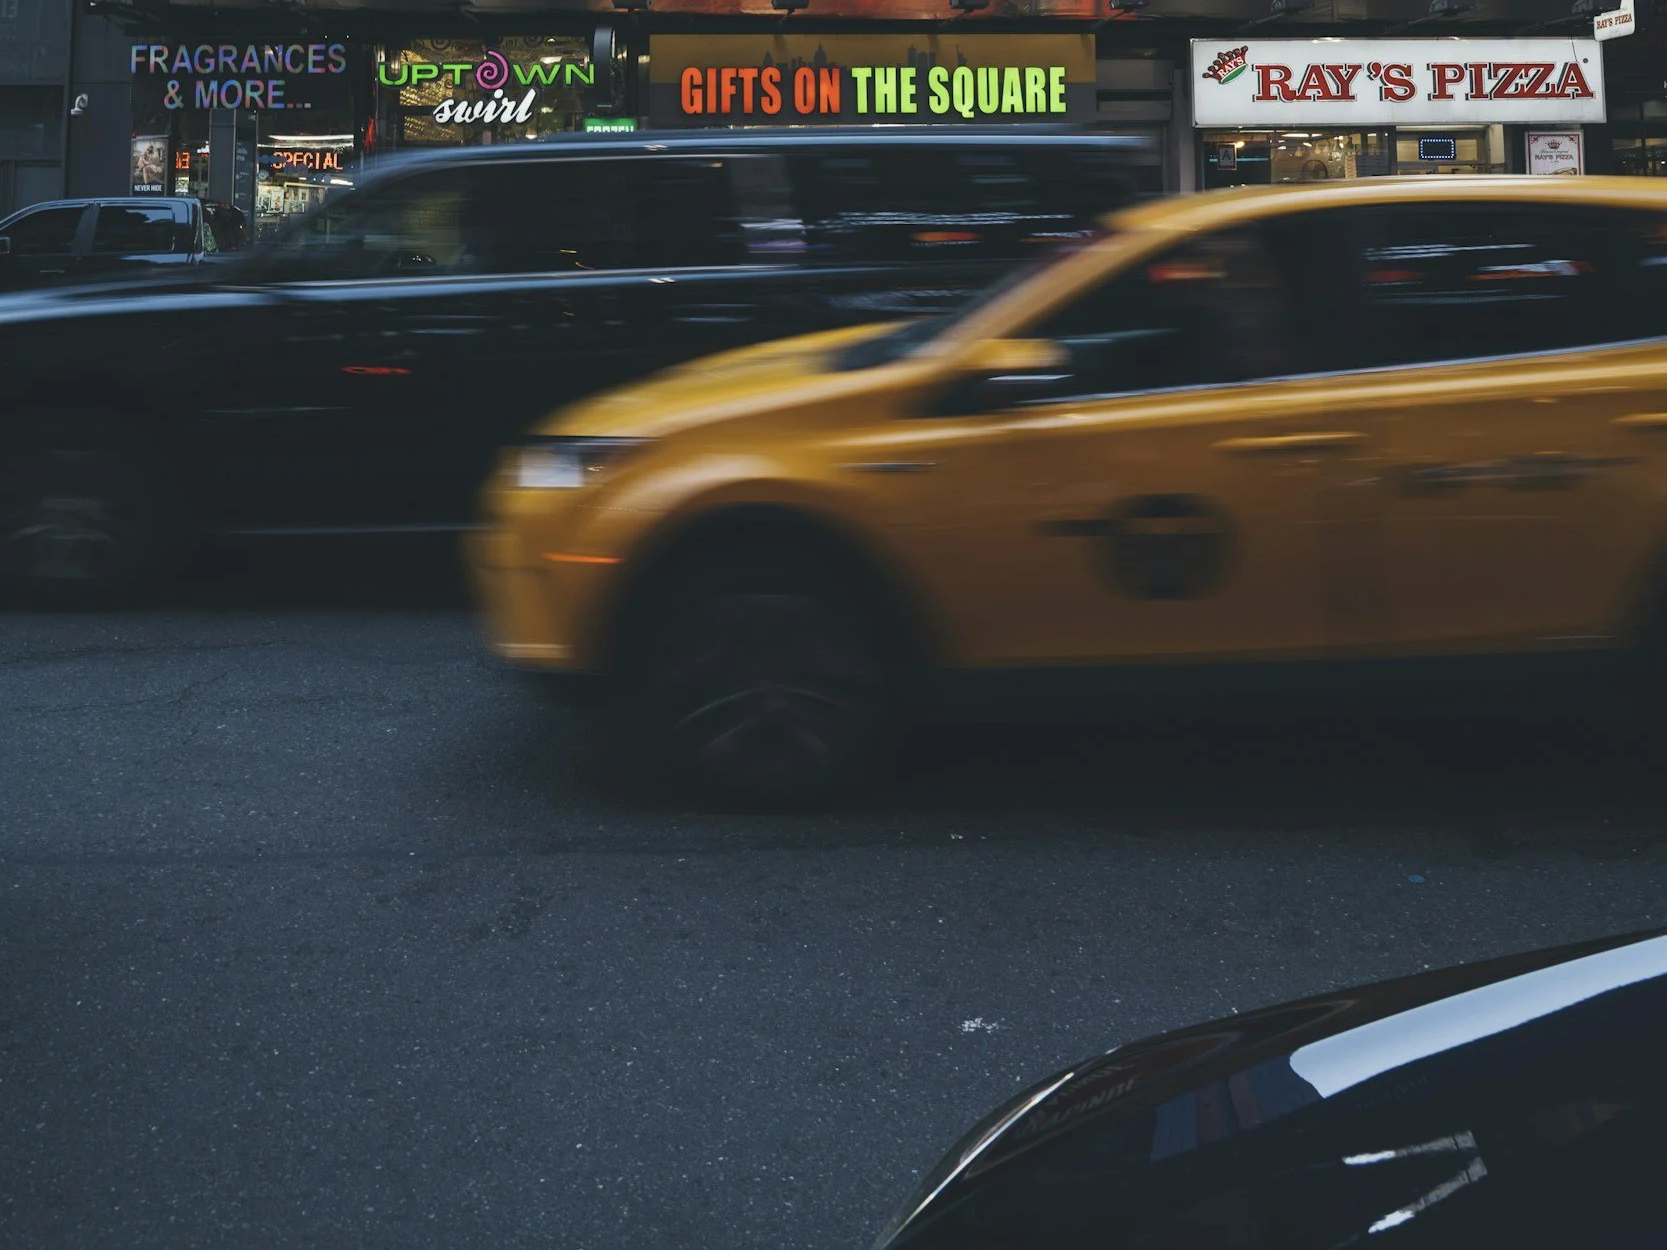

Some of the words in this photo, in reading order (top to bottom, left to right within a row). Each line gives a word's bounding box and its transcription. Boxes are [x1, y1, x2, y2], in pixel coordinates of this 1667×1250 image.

[1596, 17, 1613, 30] RAY'S
[1614, 13, 1633, 26] PIZZA
[130, 44, 346, 74] FRAGRANCES
[378, 50, 595, 90] UPTOWN
[1217, 56, 1245, 79] RAY'S
[164, 79, 183, 109] &
[680, 66, 782, 115] GIFTS
[794, 66, 840, 115] ON
[851, 66, 917, 114] THE
[928, 66, 1067, 119] SQUARE
[1252, 61, 1418, 103] RAY'S
[1426, 61, 1596, 102] PIZZA
[433, 88, 536, 124] swirl
[271, 150, 343, 170] SPECIAL
[133, 184, 150, 192] NEVER
